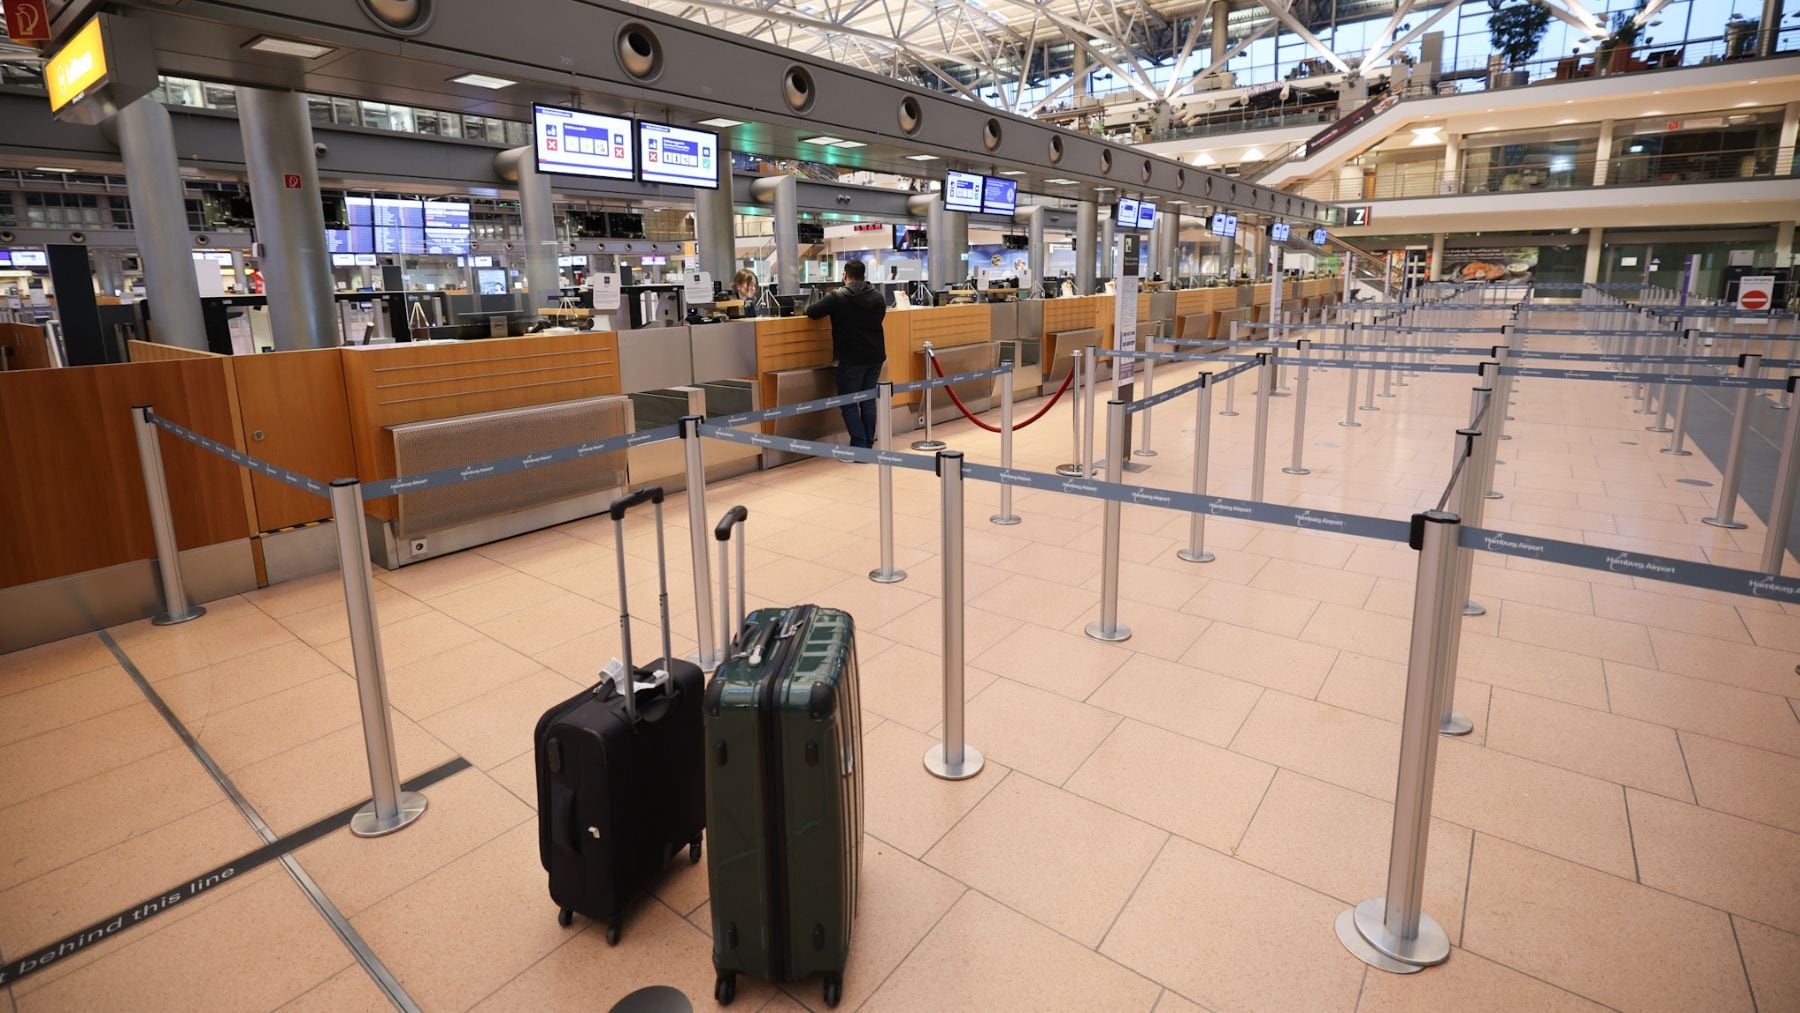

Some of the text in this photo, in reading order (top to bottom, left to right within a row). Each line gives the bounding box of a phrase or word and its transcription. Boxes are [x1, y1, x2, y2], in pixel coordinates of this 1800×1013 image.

[1209, 502, 1232, 511] Hamburg
[1295, 514, 1343, 526] Hamburg Airport
[1484, 536, 1544, 552] Hamburg Airport
[1606, 556, 1675, 573] Hamburg Airport
[1749, 580, 1793, 594] Hamburg
[18, 918, 123, 974] behind
[132, 892, 182, 920] this
[190, 867, 235, 894] line
